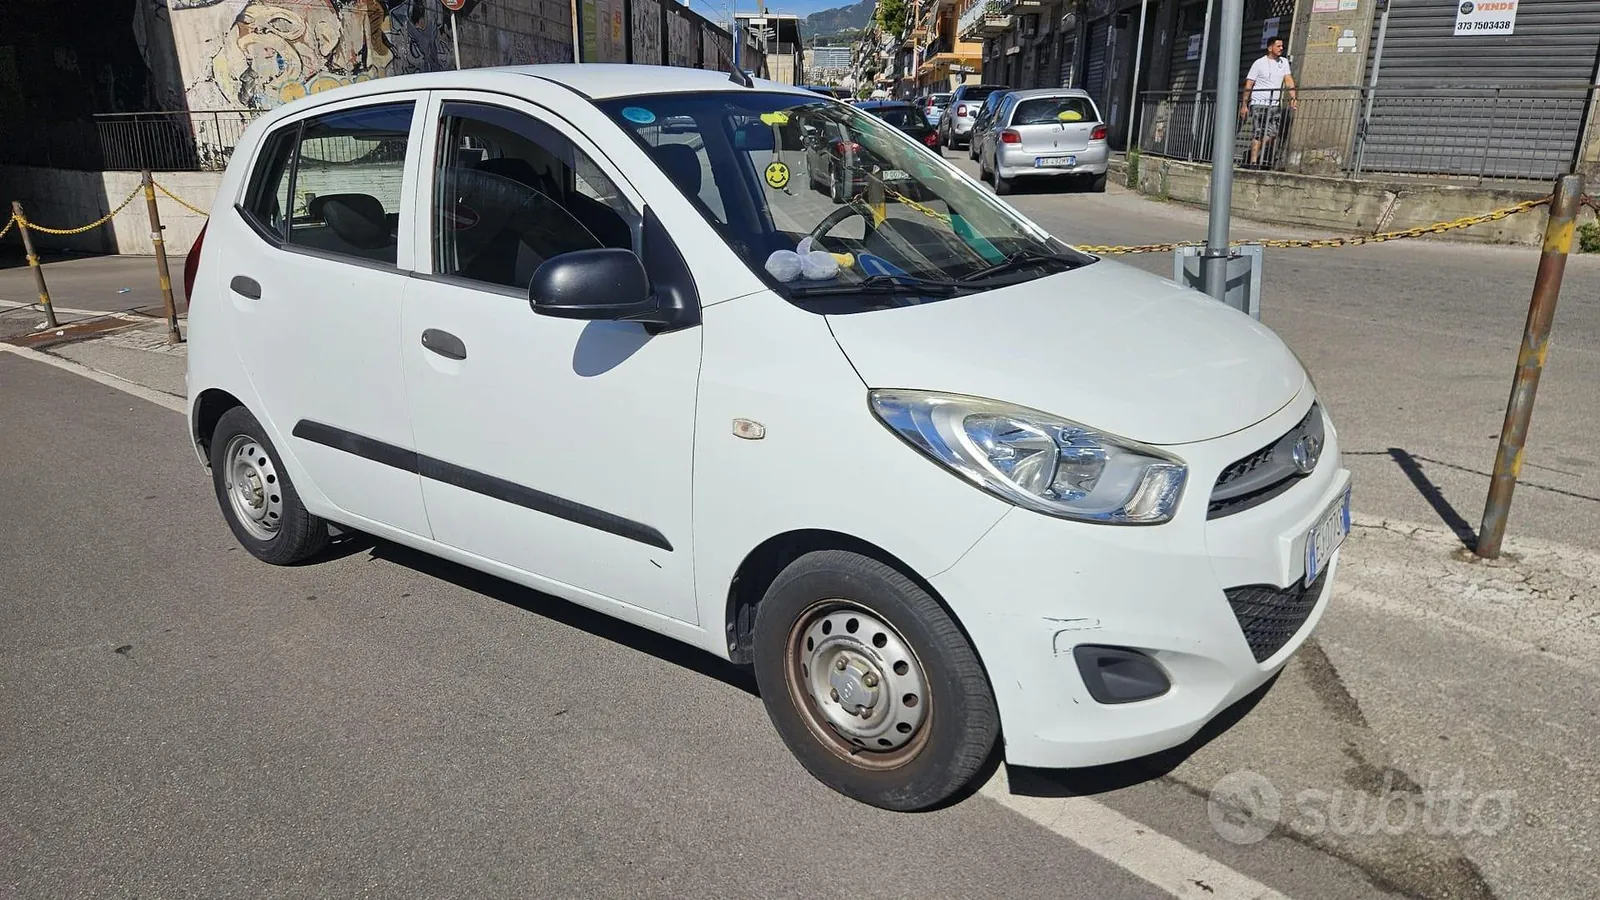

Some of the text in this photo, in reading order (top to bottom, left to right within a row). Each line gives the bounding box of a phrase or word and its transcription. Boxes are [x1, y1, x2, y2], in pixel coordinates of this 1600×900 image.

[1477, 3, 1515, 11] VENDE
[1457, 21, 1511, 30] 373 7503438
